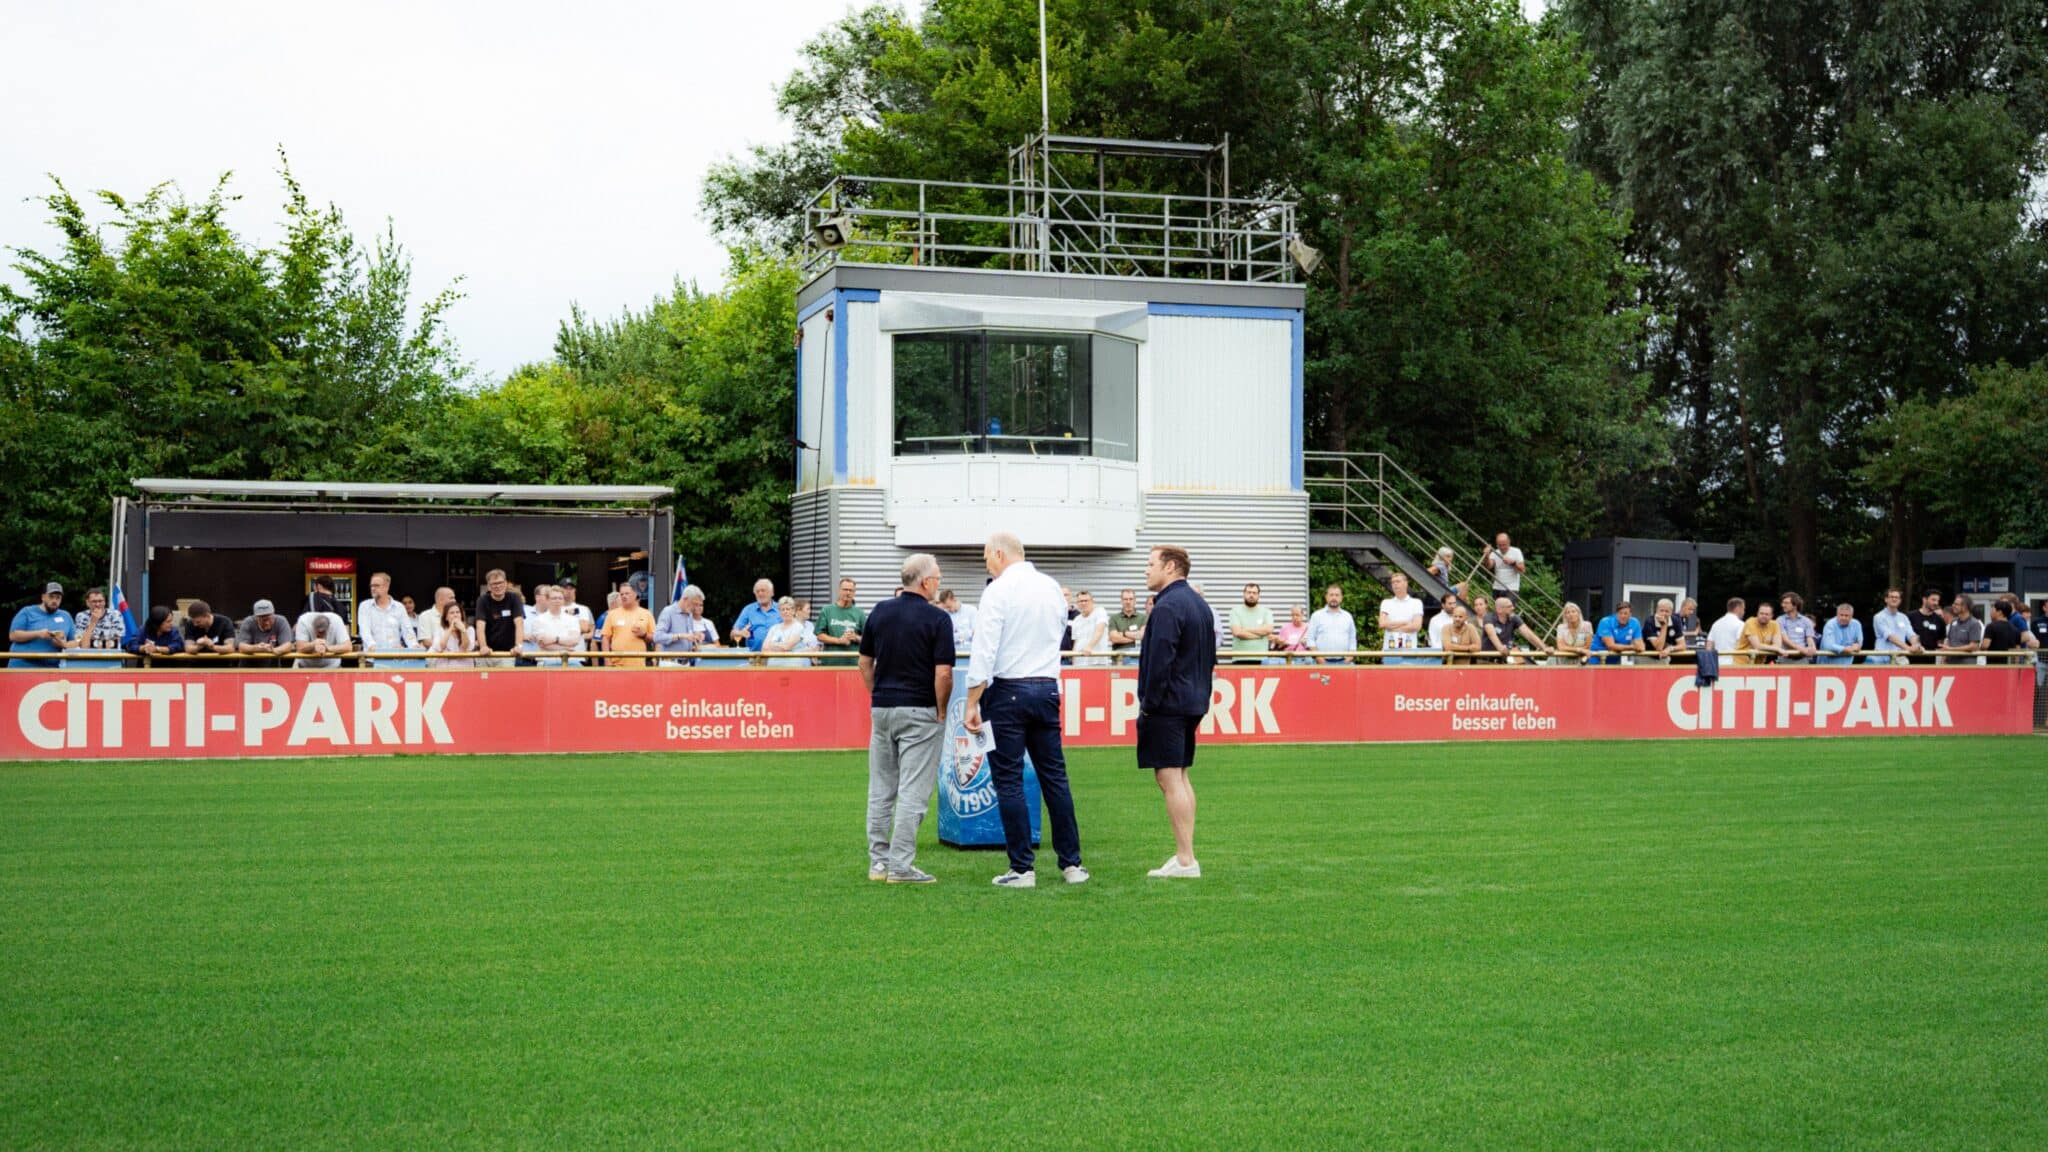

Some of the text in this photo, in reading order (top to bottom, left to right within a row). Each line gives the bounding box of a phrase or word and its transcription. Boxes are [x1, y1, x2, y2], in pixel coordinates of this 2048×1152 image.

[594, 698, 773, 720] Besser einkaufen,
[1394, 693, 1539, 713] Besser einkaufen,
[1666, 675, 1955, 731] CITTI-PARK
[18, 681, 454, 750] CITTI-PARK
[1452, 712, 1557, 730] besser leben
[667, 719, 794, 739] besser leben
